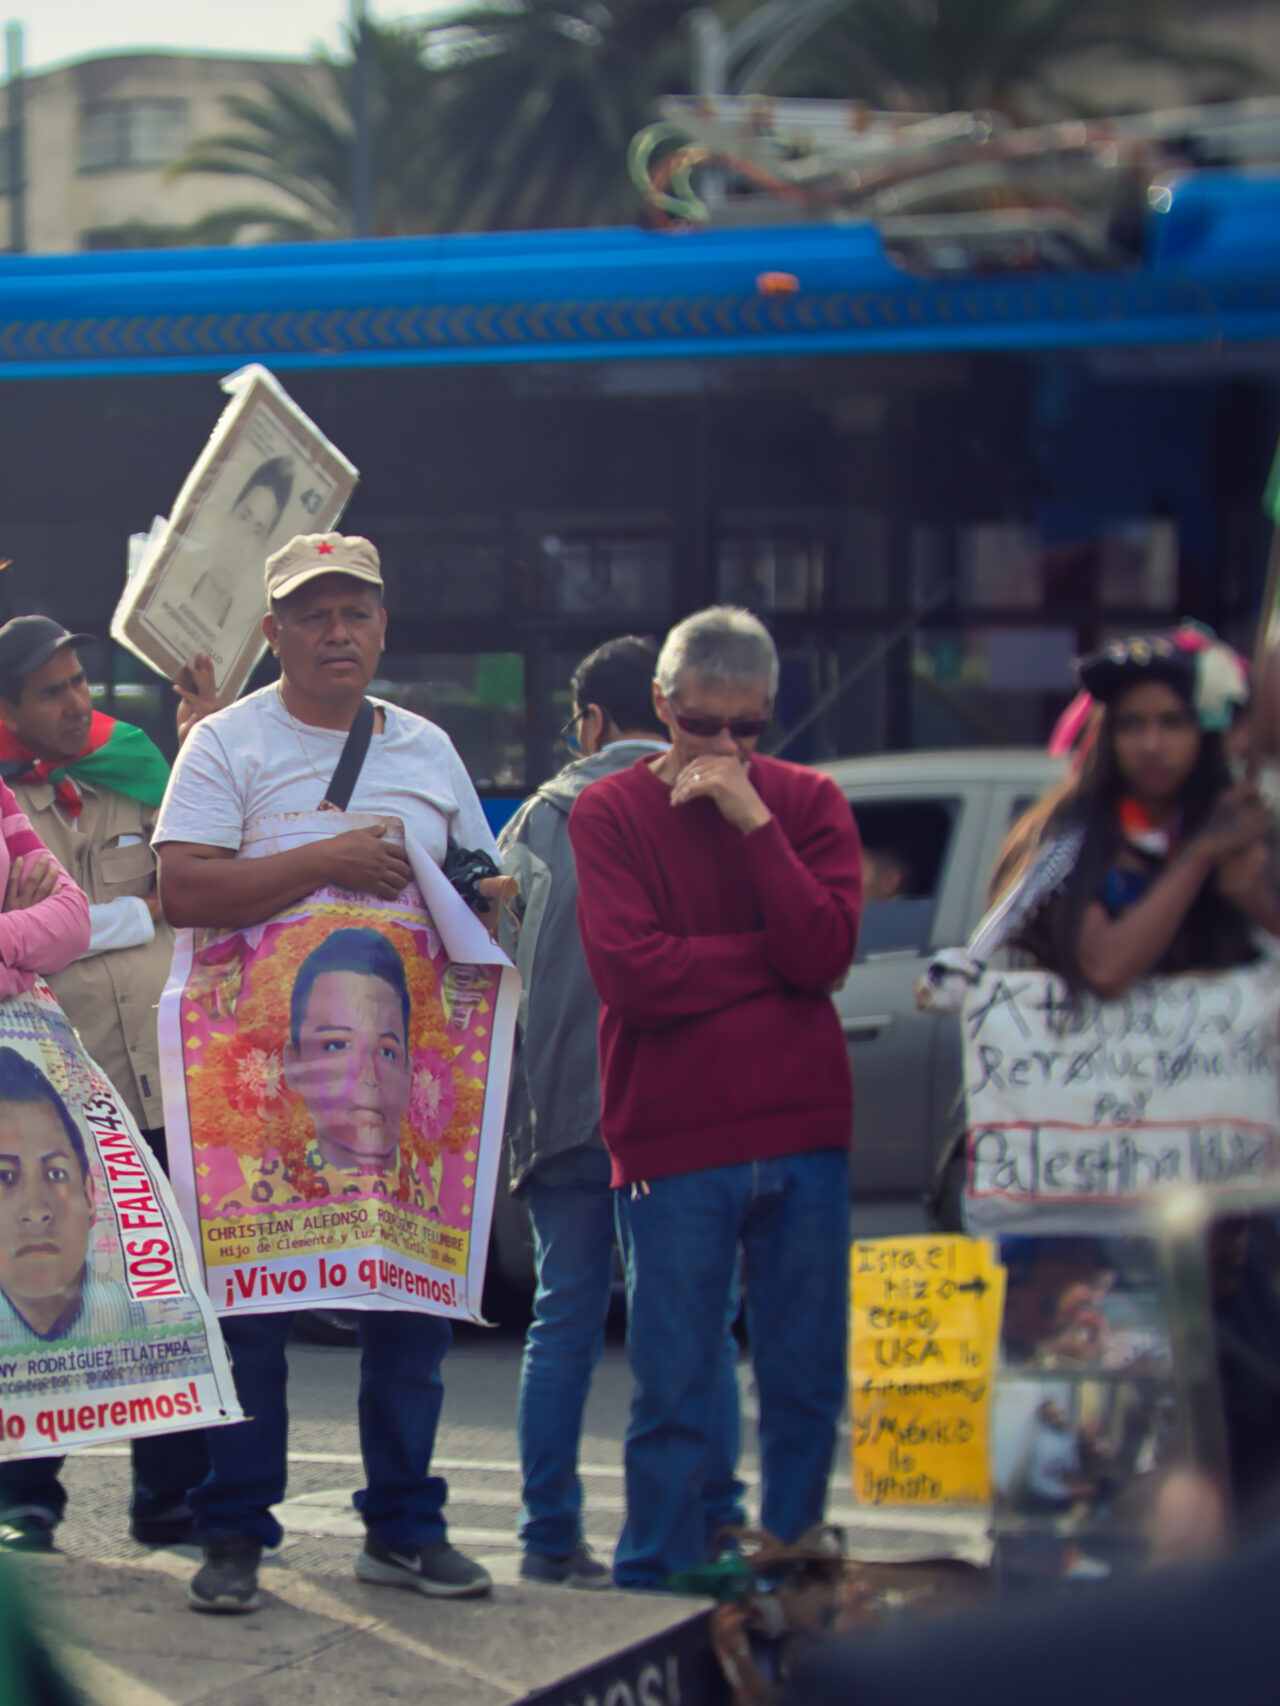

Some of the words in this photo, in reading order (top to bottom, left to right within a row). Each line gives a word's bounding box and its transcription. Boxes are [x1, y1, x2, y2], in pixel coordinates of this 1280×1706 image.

[95, 1131, 163, 1230] FALTAN
[207, 1218, 294, 1242] CHRISTIAN
[303, 1208, 368, 1231] ALFONSO
[220, 1244, 250, 1259] Hijo
[257, 1241, 271, 1254] de
[277, 1234, 334, 1251] Clemente
[340, 1233, 348, 1245] y
[354, 1228, 375, 1240] Luz
[126, 1237, 182, 1298] NOS
[225, 1266, 308, 1308] ¡Vivo
[318, 1257, 348, 1290] lo
[357, 1258, 458, 1308] queremos!
[27, 1349, 113, 1376] RODRÍGUEZ
[36, 1382, 203, 1443] queremos!
